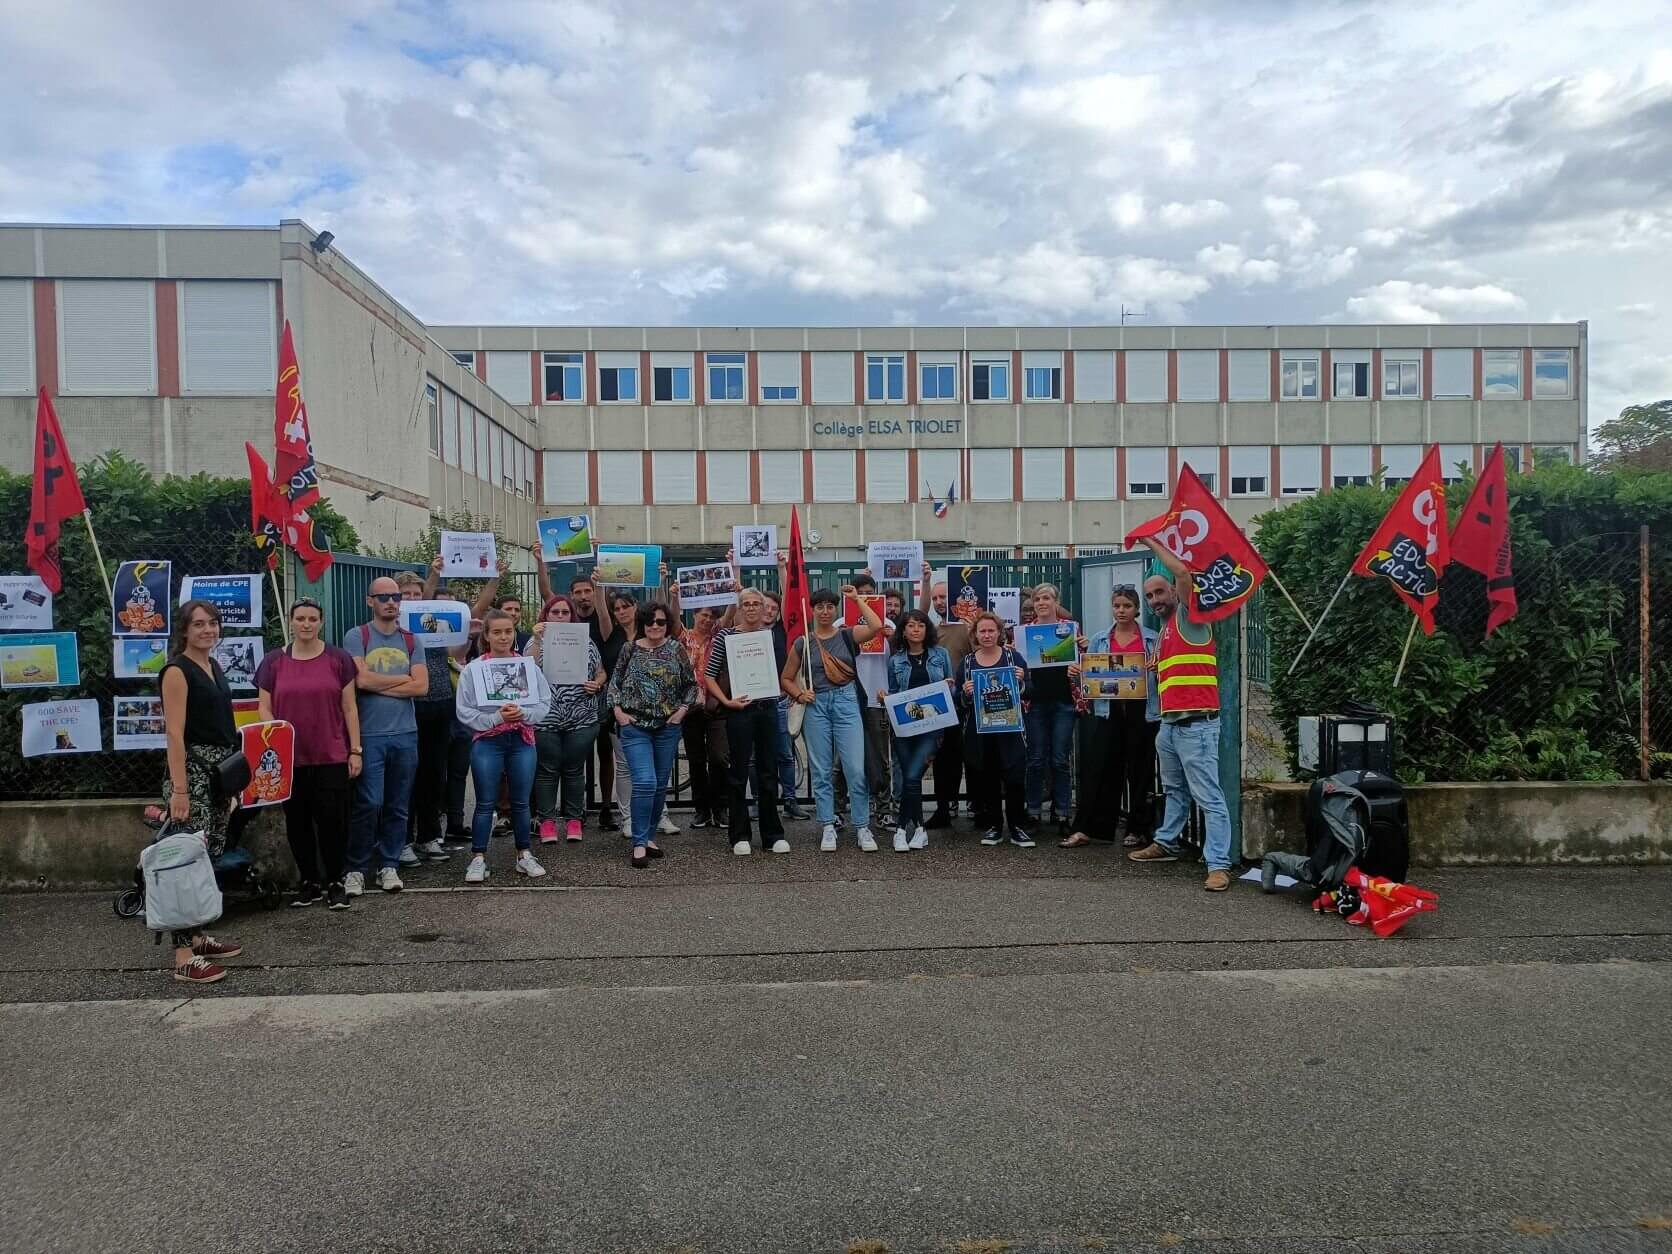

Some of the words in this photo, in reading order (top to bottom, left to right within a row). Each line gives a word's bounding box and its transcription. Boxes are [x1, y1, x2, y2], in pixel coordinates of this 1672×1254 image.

[813, 422, 863, 437] Collège
[868, 420, 902, 434] ELSA
[907, 419, 961, 433] TRIOLET
[56, 703, 80, 714] SAVE
[40, 718, 58, 728] THE
